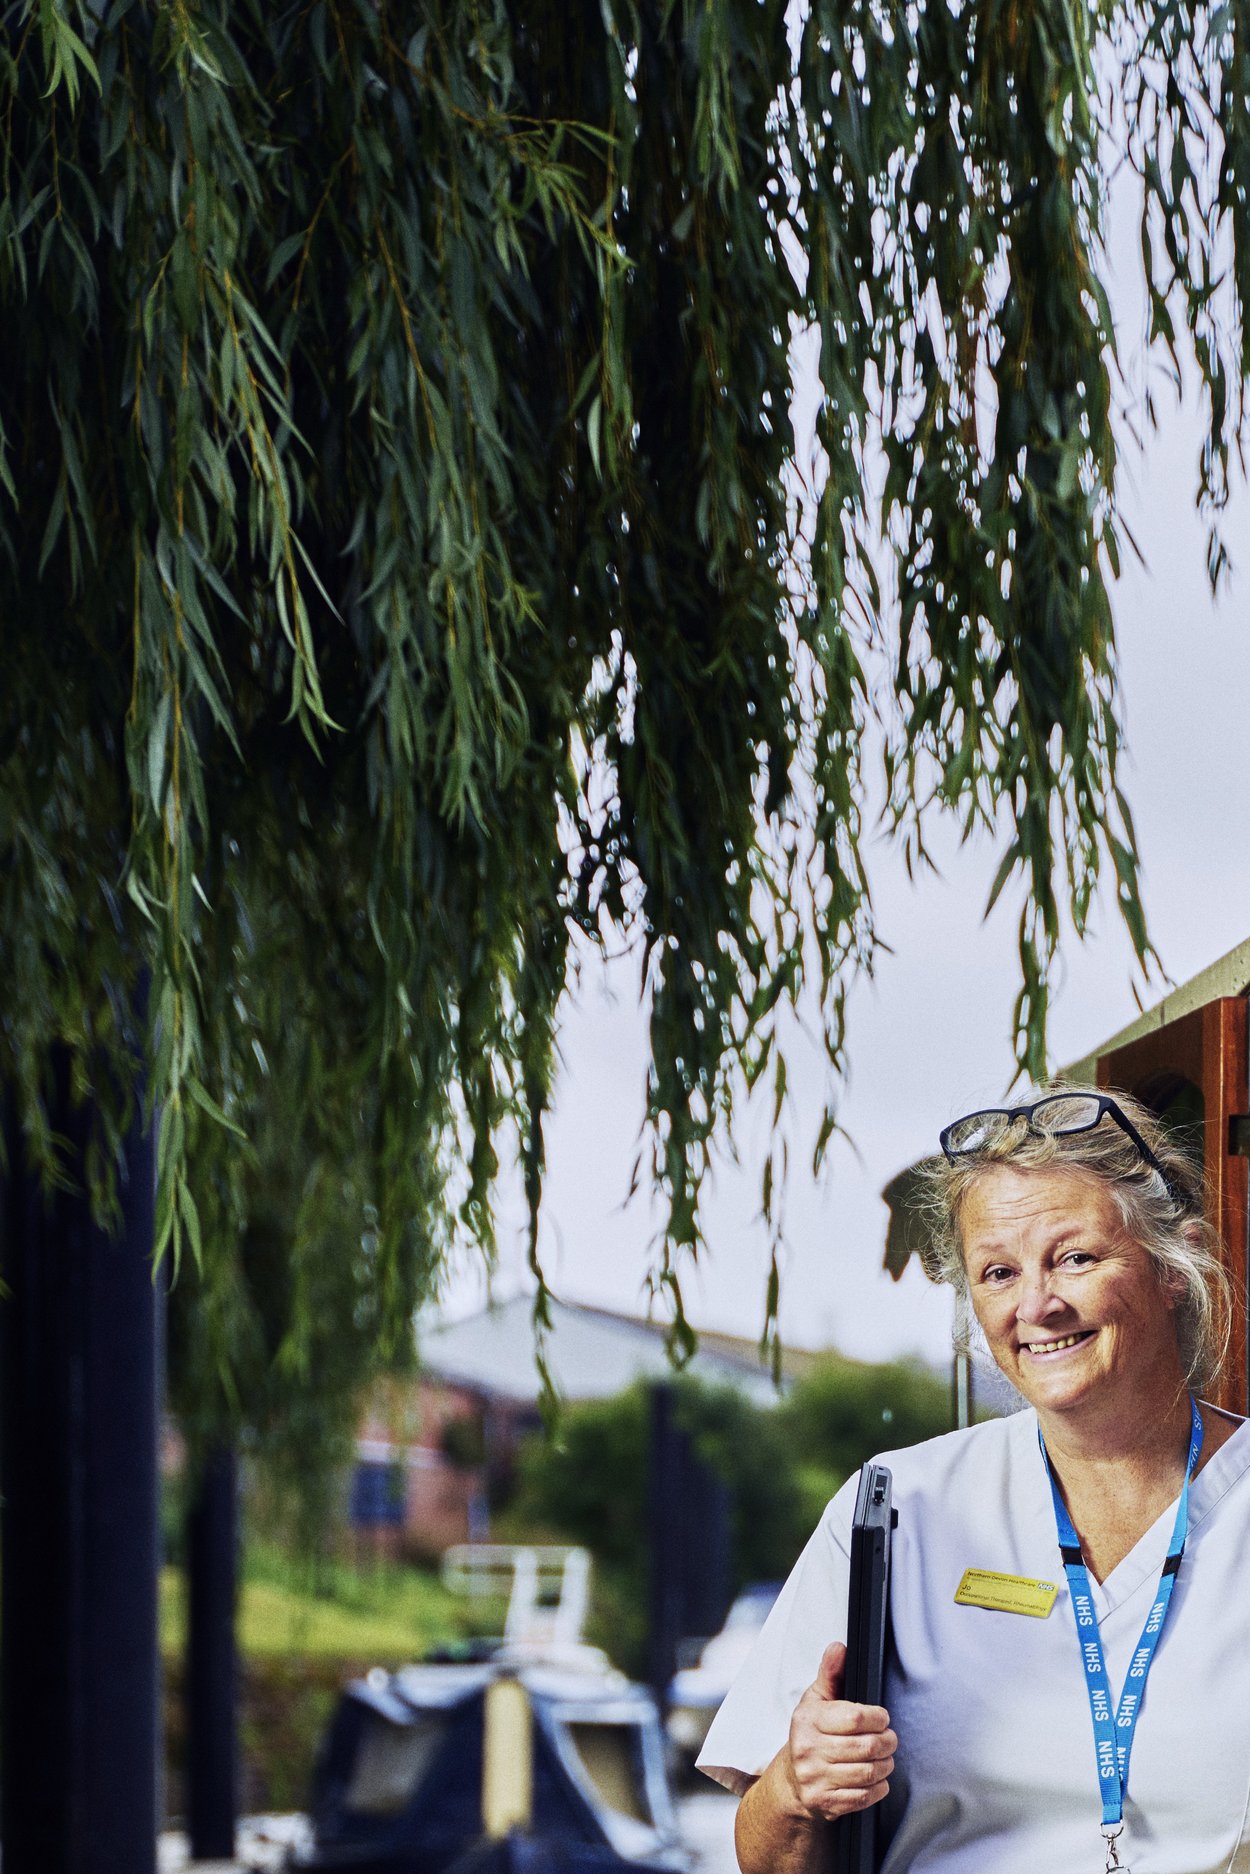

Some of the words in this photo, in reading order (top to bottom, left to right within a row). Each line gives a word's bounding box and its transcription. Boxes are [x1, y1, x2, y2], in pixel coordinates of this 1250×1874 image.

[1038, 1582, 1055, 1591] NHS
[1075, 1595, 1093, 1626] NHS
[1145, 1601, 1165, 1633] NHS
[1084, 1642, 1102, 1673] NHS
[1130, 1647, 1151, 1678] NHS
[1091, 1690, 1109, 1722] NHS
[1117, 1694, 1138, 1727] NHS
[1098, 1740, 1115, 1778] NHS
